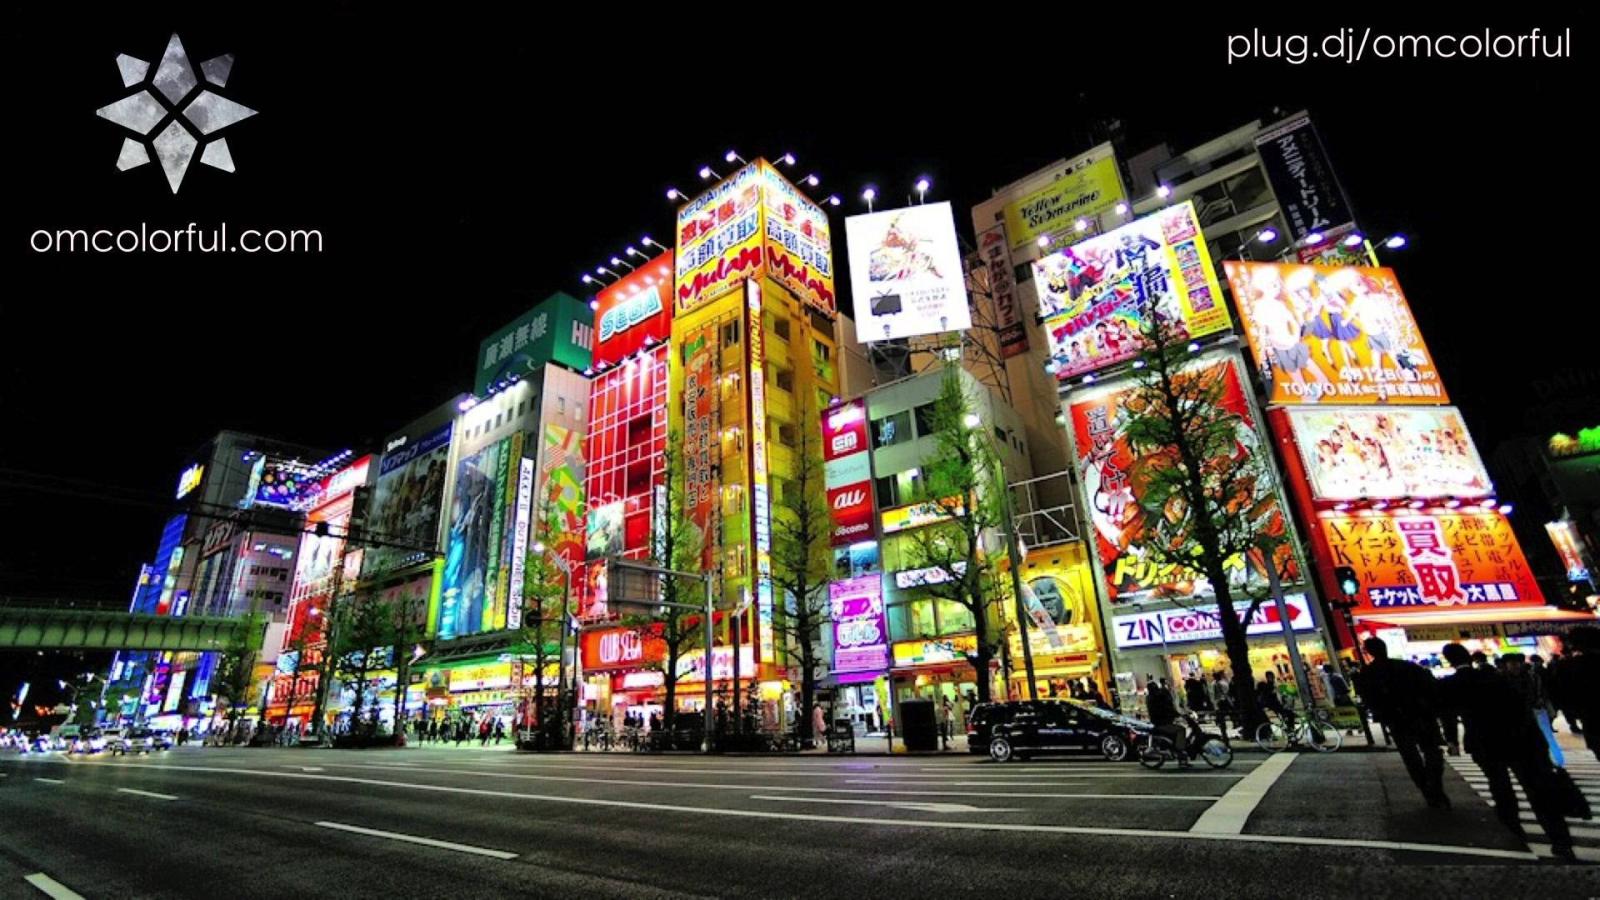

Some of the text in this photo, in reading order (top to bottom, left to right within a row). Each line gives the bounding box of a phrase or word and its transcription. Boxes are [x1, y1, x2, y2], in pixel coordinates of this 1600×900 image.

[1021, 194, 1063, 218] Yellow
[601, 287, 660, 337] SEGA
[1279, 381, 1337, 397] TOKYO
[834, 489, 865, 510] au
[835, 523, 869, 537] docomo
[1361, 520, 1386, 565] アニメ
[1345, 520, 1377, 583] アイドル
[1399, 520, 1464, 602] 買取
[1441, 518, 1474, 581] フィギュア
[1369, 583, 1518, 605] チケット大黒屋
[1119, 616, 1162, 642] ZIN
[600, 630, 643, 663] CLUB SEGA
